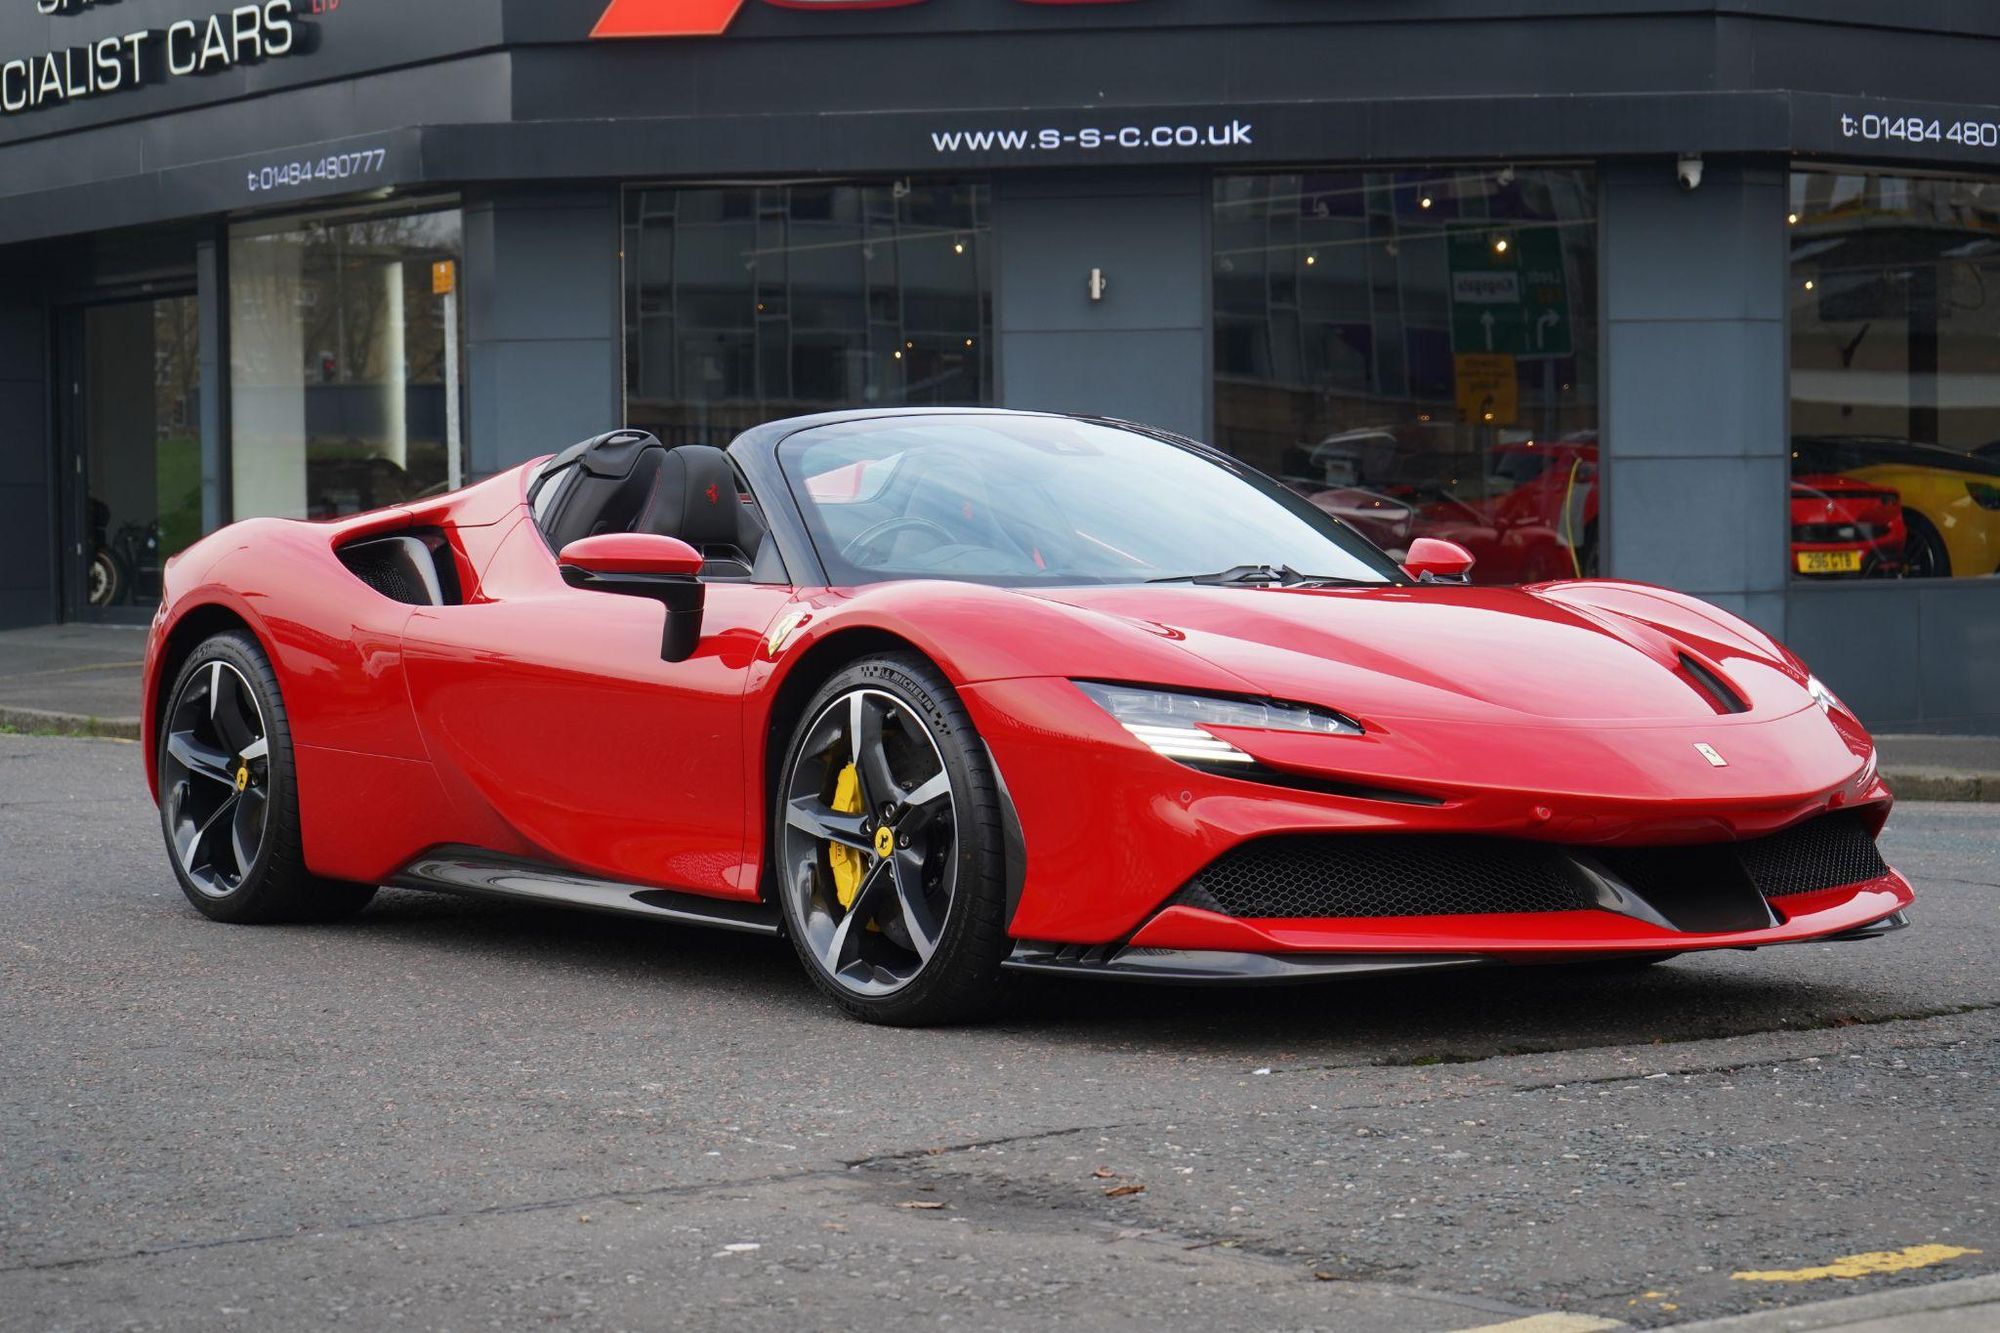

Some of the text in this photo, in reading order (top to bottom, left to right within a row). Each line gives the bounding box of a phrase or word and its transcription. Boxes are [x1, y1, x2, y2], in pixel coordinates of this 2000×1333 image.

[0, 30, 149, 111] CIALIST
[168, 0, 293, 75] CARS
[931, 119, 1252, 151] www.s-s-c.co.uk
[1945, 121, 2000, 147] 480
[314, 148, 386, 180] 480777
[890, 670, 936, 712] MICHELIN
